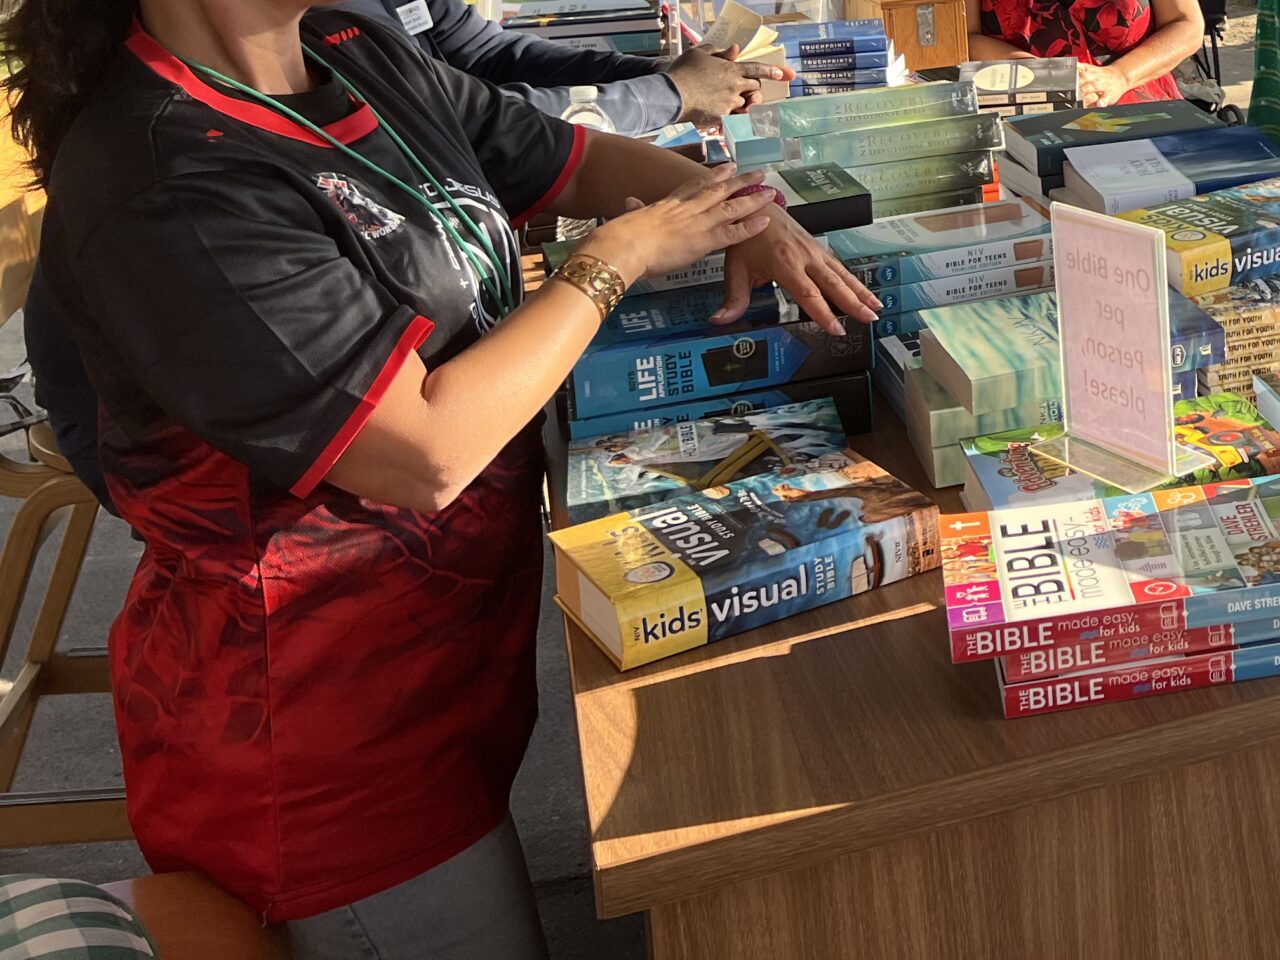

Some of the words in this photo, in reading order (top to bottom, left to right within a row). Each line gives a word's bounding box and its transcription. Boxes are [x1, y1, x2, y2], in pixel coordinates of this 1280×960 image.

[801, 42, 850, 51] TOUCHPOINTS
[843, 96, 927, 113] RECOVERY
[846, 111, 900, 121] DEVOTIONAL
[903, 108, 926, 116] BIBLE
[867, 129, 950, 148] RECOVERY
[1148, 205, 1239, 234] visual
[968, 248, 984, 256] NIV
[945, 260, 965, 268] BIBLE
[667, 272, 688, 281] BIBLE
[692, 268, 707, 276] FOR
[968, 275, 985, 284] NIV
[946, 287, 966, 296] BIBLE
[969, 284, 982, 292] FOR
[986, 280, 1007, 288] TEENS
[1242, 315, 1262, 324] YOUTH
[1242, 327, 1254, 335] FOR
[1256, 324, 1275, 334] YOUTH
[1228, 343, 1247, 352] TRUTH
[1248, 340, 1260, 348] FOR
[1261, 338, 1280, 347] YOUTH
[1240, 355, 1251, 363] FOR
[1253, 352, 1273, 361] YOUTH
[636, 356, 657, 402] LIFE
[656, 355, 666, 398] APPLICATION
[665, 353, 678, 396] STUDY
[680, 350, 694, 393] BIBLE
[1218, 371, 1237, 381] TRUTH
[1238, 369, 1251, 377] FOR
[1085, 505, 1102, 525] kids
[1235, 502, 1268, 541] STREHLER
[705, 517, 735, 541] STUDY
[1222, 515, 1243, 536] DAVE
[635, 506, 730, 567] visual
[1000, 518, 1067, 600] BIBLE
[816, 556, 825, 594] STUDY
[827, 554, 836, 590] BIBLE
[1074, 559, 1105, 600] made
[711, 565, 808, 623] visual
[1228, 601, 1253, 613] DAVE
[967, 633, 977, 655] THE
[976, 622, 1055, 655] BIBLE
[1057, 616, 1099, 631] made
[1102, 611, 1139, 628] easy-
[1099, 625, 1116, 637] for
[1118, 622, 1141, 634] kids
[1020, 652, 1030, 675] THE
[1029, 641, 1106, 673] BIBLE
[1109, 635, 1149, 649] made
[1149, 643, 1166, 655] for
[1168, 640, 1189, 651] kids
[1020, 689, 1030, 711] THE
[1028, 678, 1105, 710] BIBLE
[1109, 671, 1149, 686] made
[1151, 666, 1193, 680] easy-
[1150, 677, 1166, 690] for
[1168, 676, 1192, 688] kids
